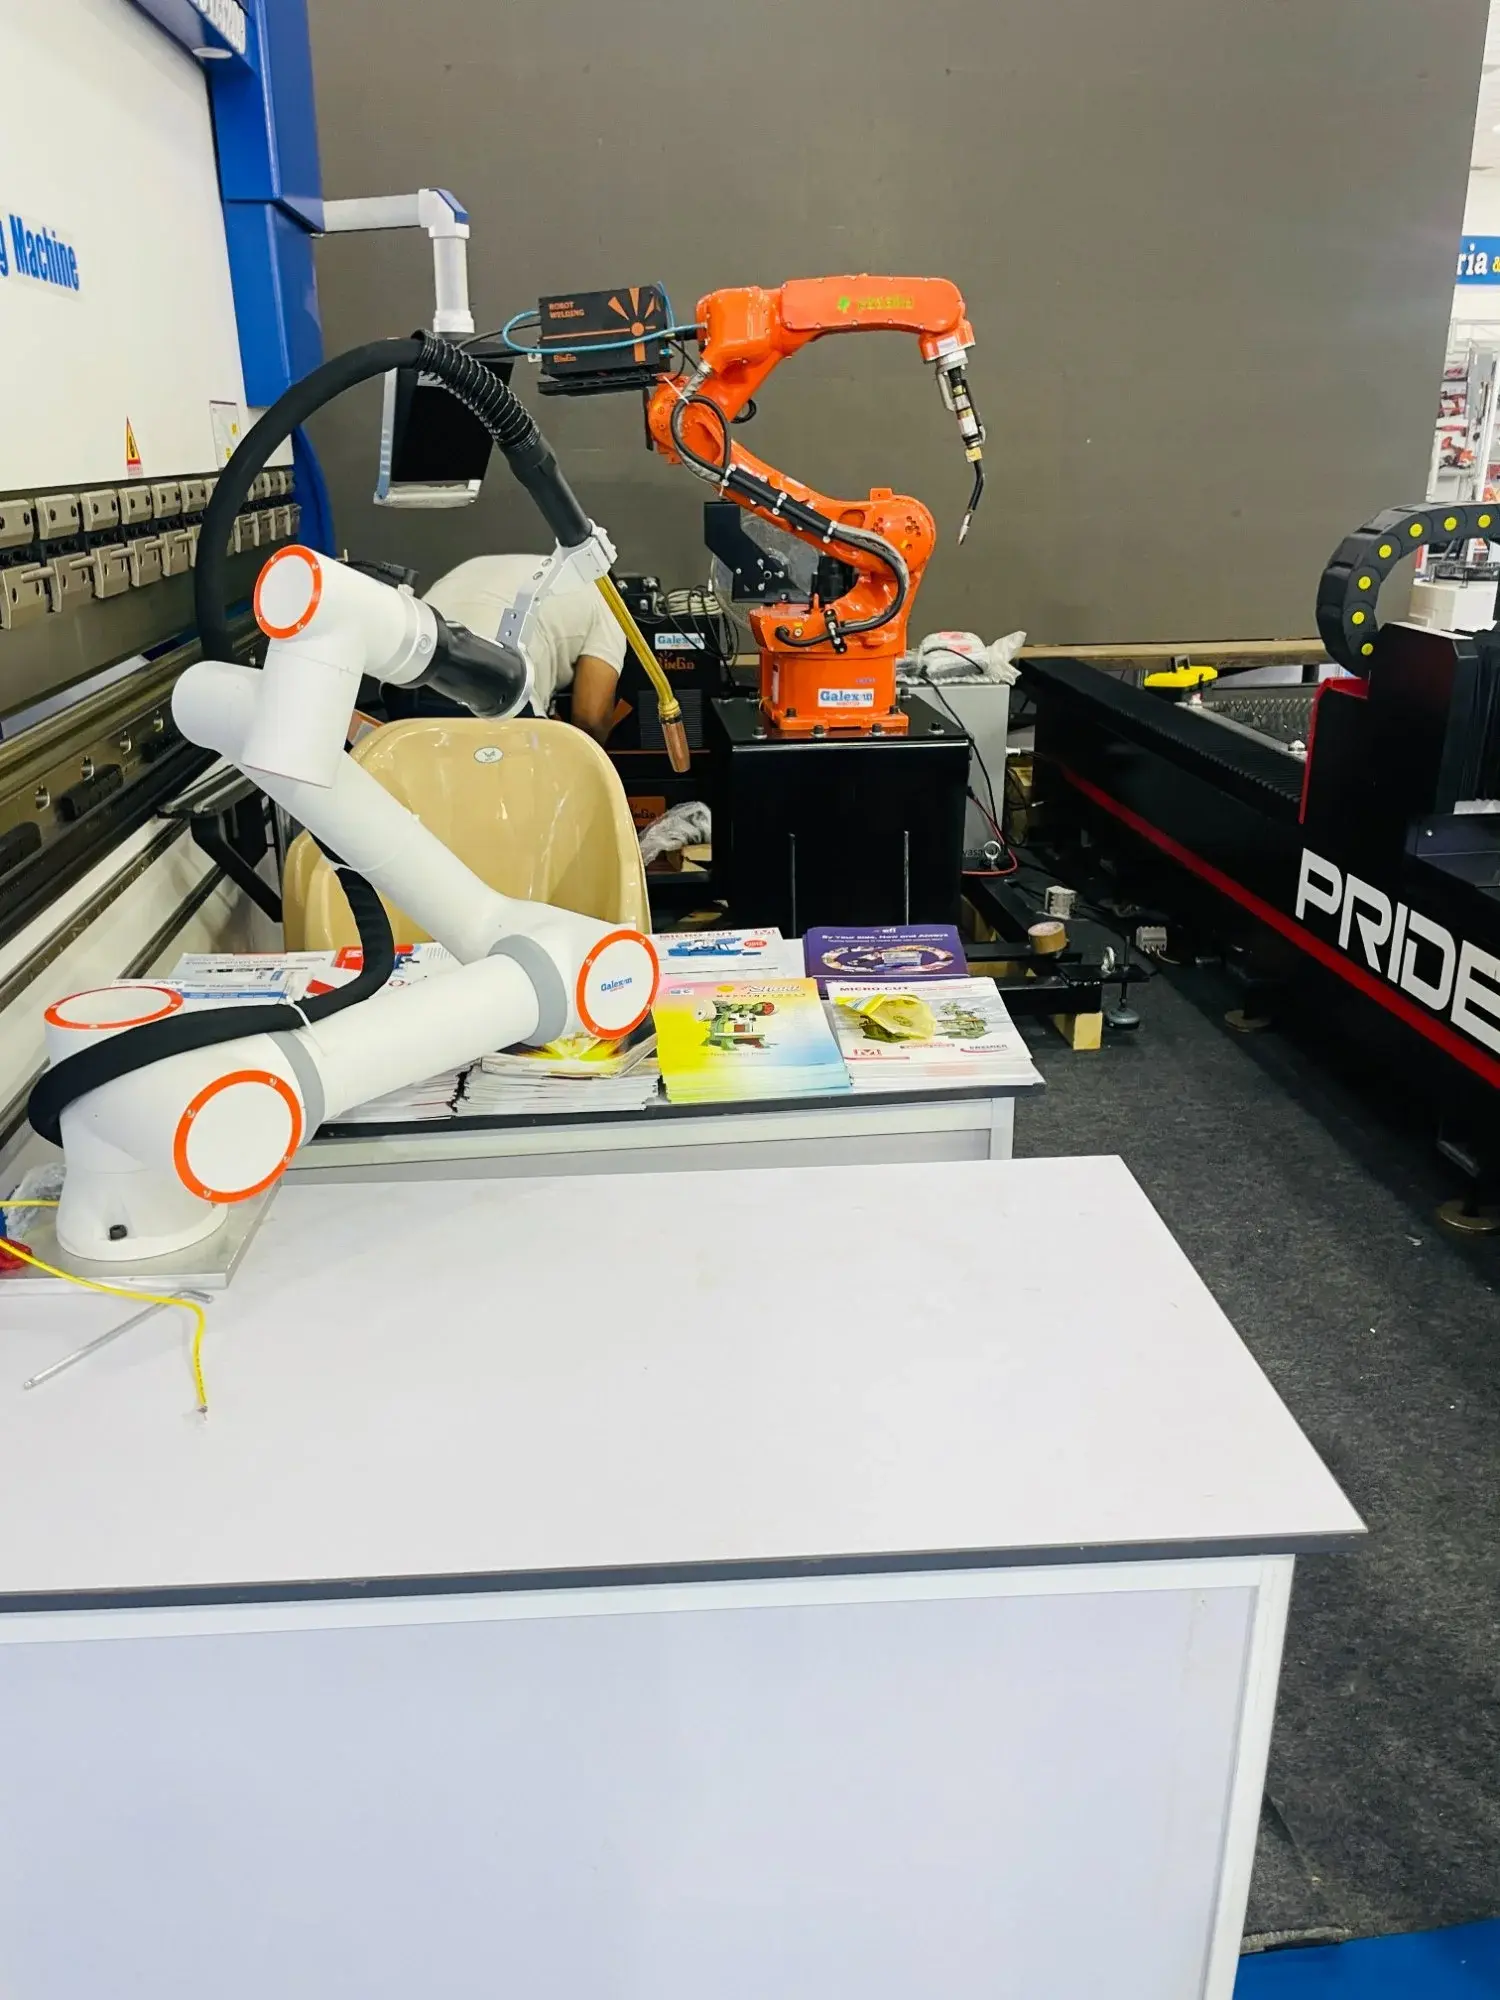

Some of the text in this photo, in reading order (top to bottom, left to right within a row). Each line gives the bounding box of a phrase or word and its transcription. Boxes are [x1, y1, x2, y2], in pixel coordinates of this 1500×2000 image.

[9, 213, 80, 292] Machine
[548, 301, 574, 310] ROBOT
[550, 309, 585, 319] WELDING
[1295, 847, 1500, 1055] PRIDE
